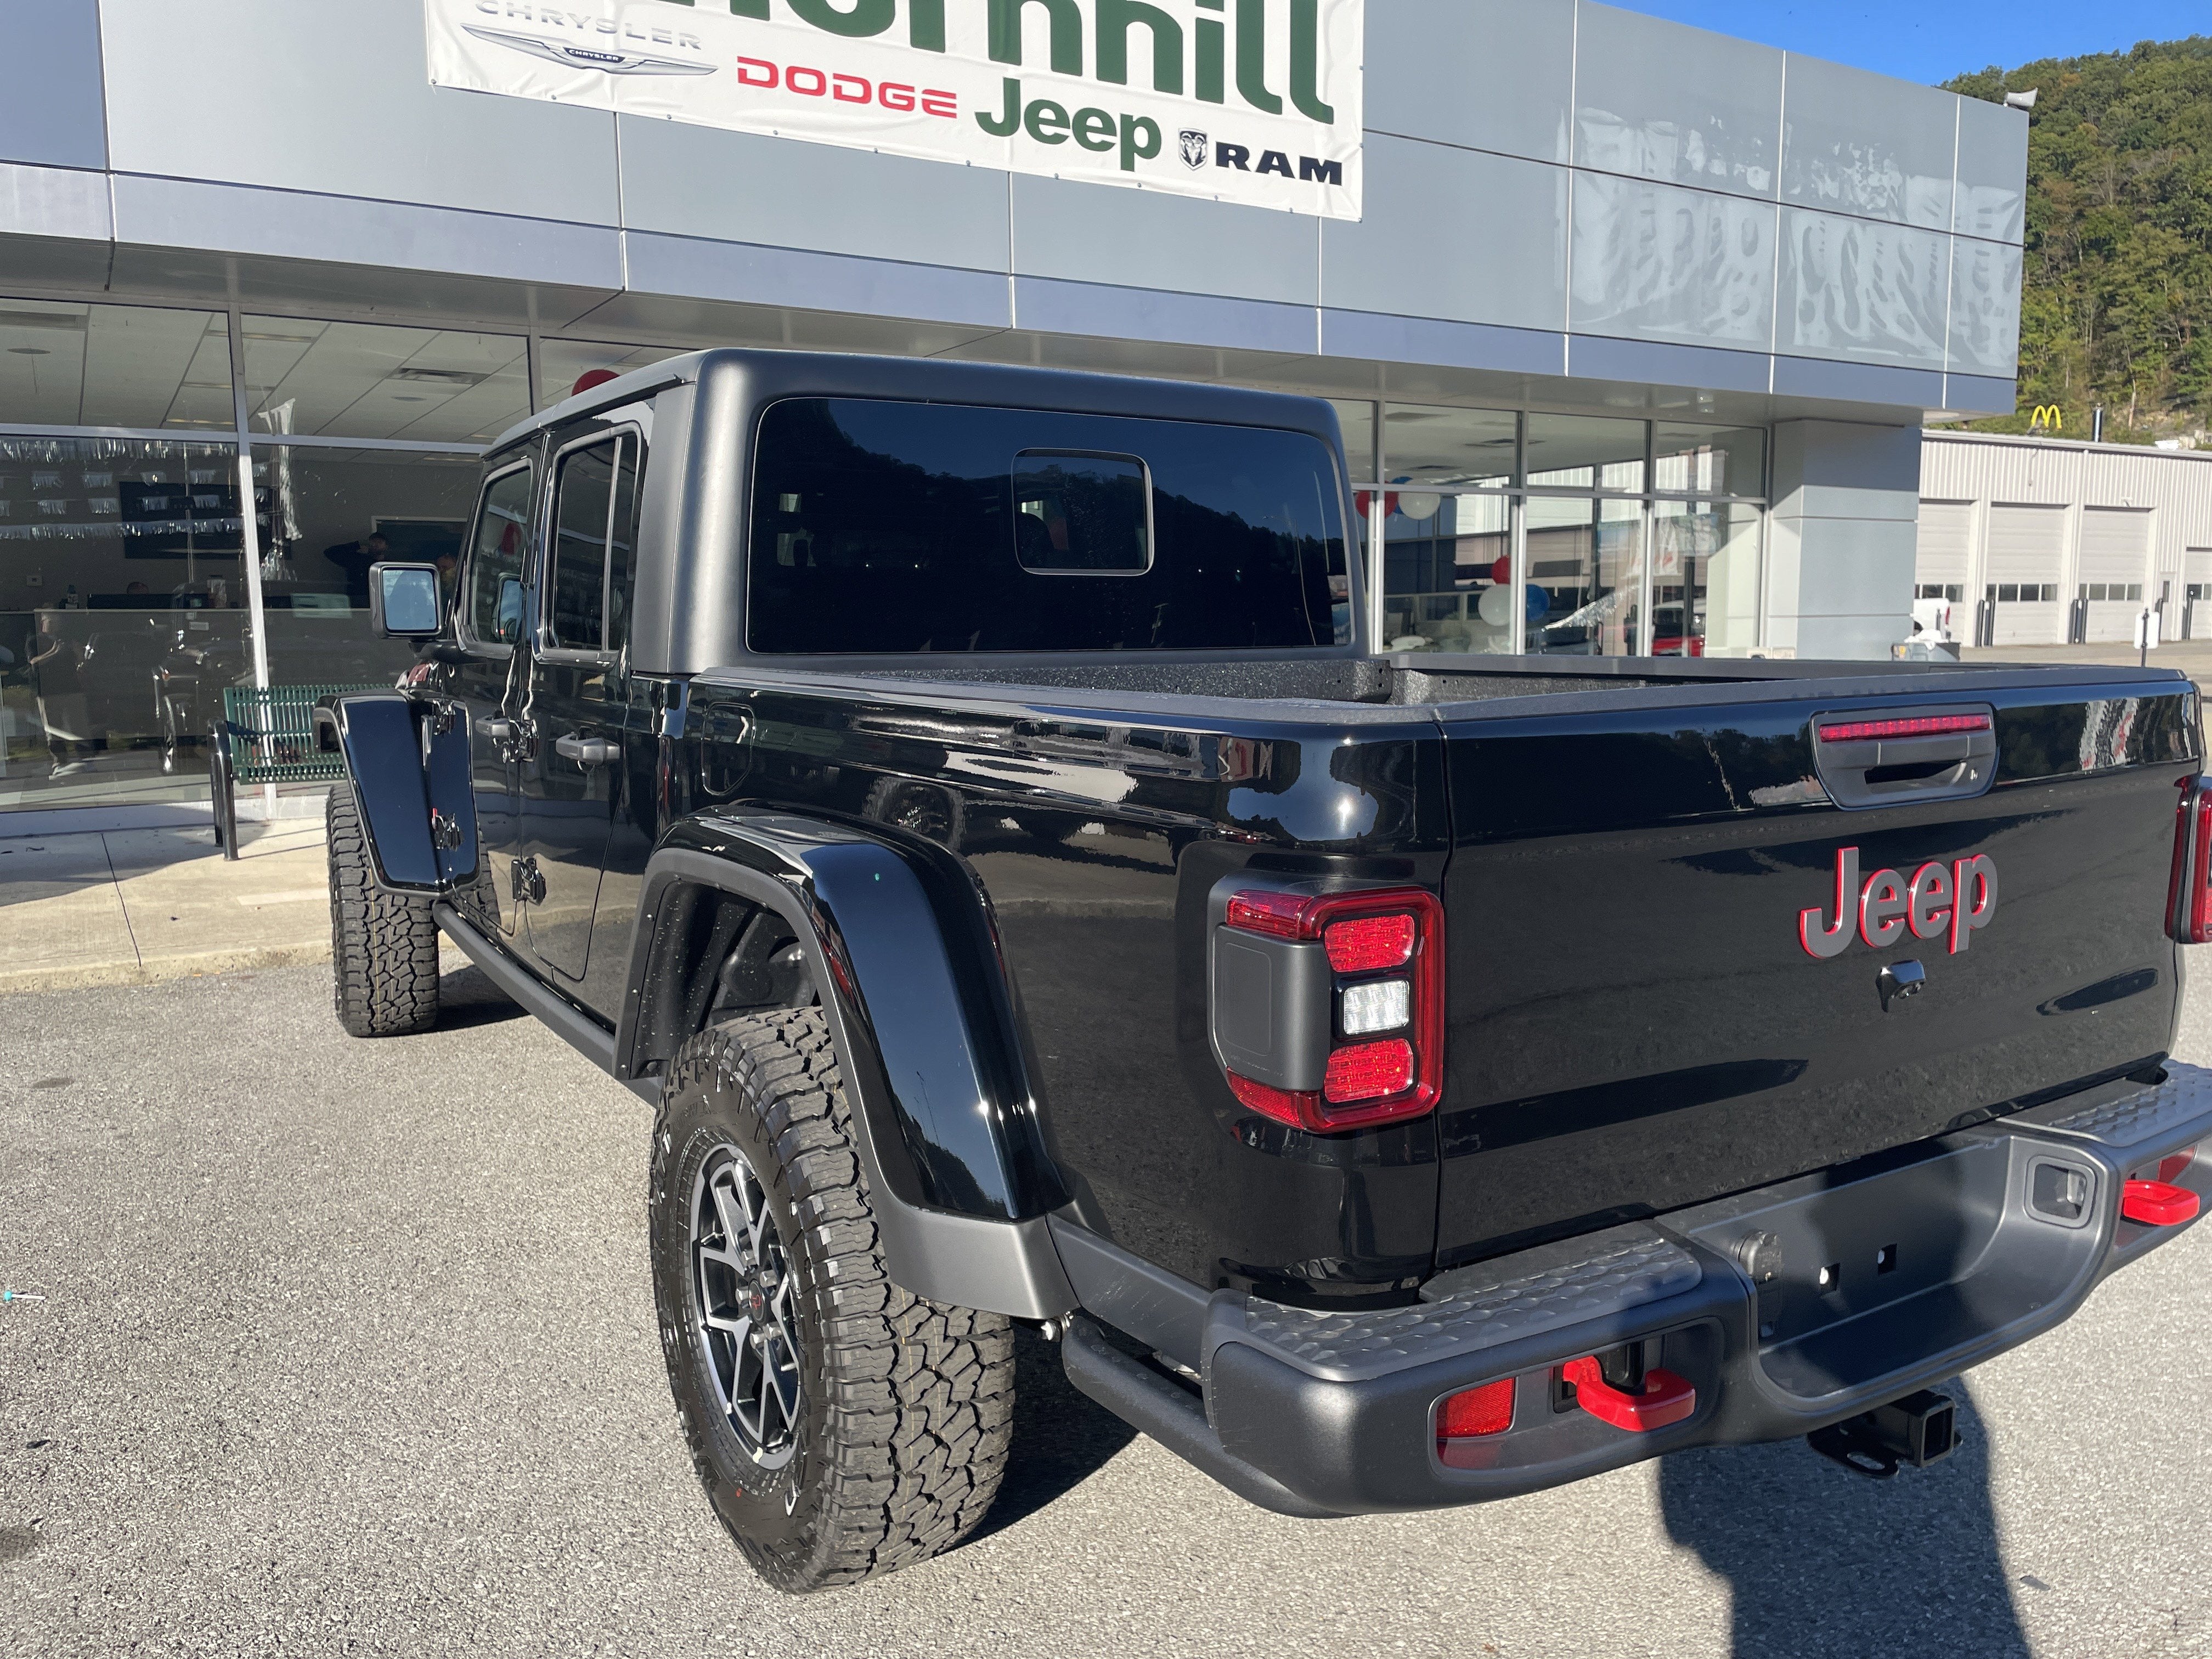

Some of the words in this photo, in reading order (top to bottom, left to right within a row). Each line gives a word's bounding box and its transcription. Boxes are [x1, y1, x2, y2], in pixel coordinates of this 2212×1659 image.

[476, 1, 702, 50] CHRYSLER
[568, 49, 619, 61] CHRYSLER
[737, 56, 957, 119] DODGE
[974, 77, 1162, 171] Jeep
[1215, 141, 1343, 186] RAM
[1799, 846, 1998, 960] Jeep
